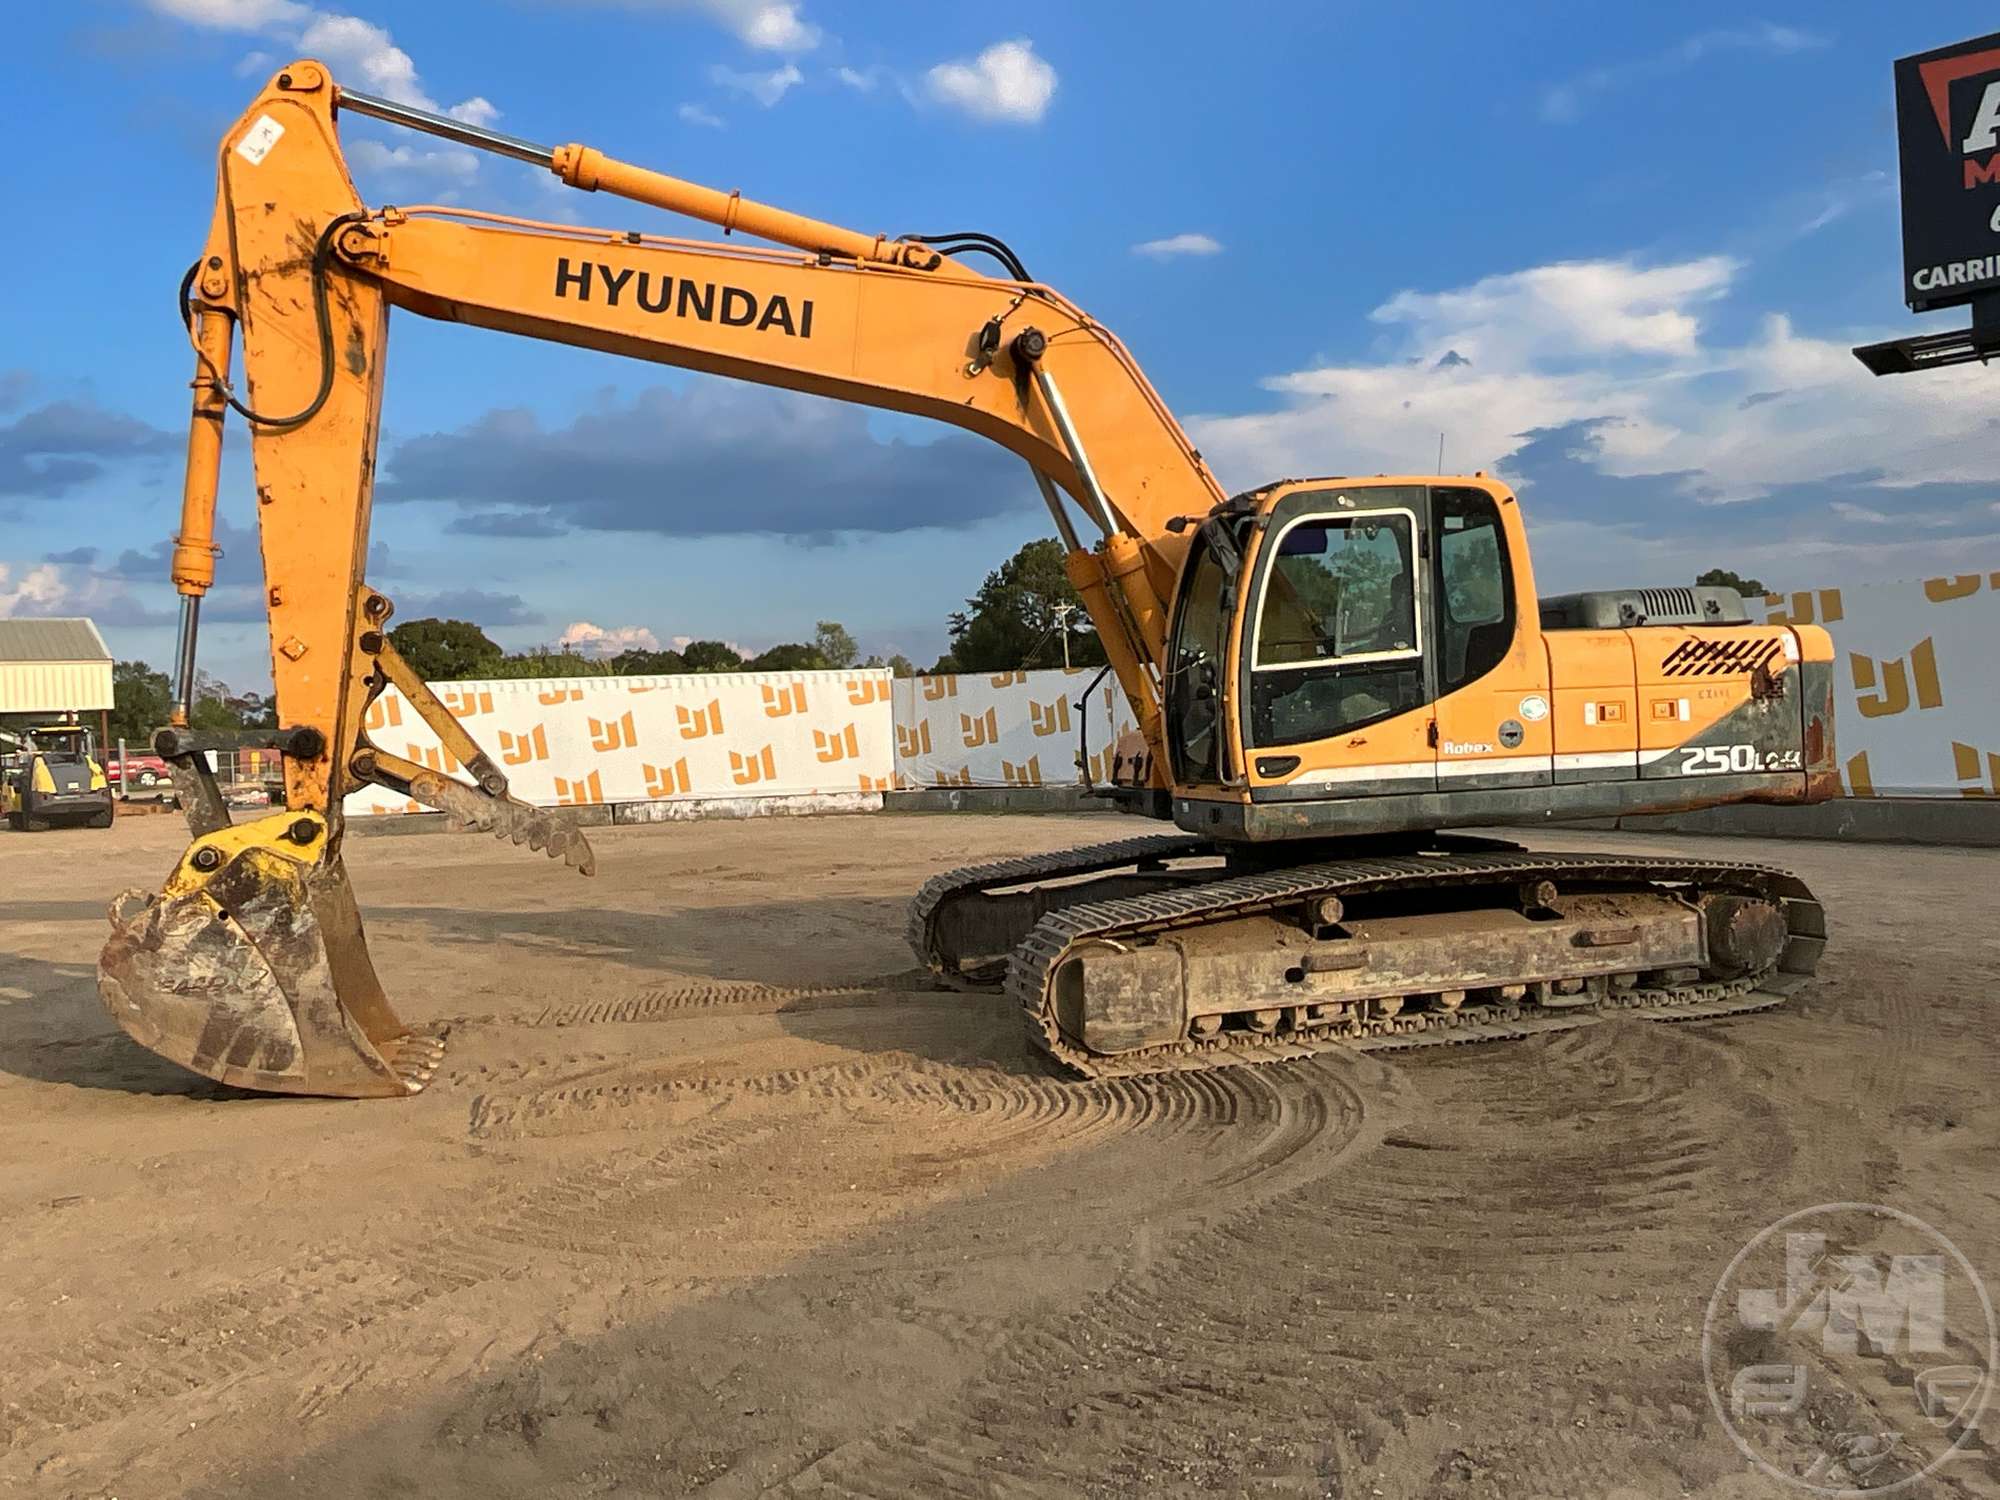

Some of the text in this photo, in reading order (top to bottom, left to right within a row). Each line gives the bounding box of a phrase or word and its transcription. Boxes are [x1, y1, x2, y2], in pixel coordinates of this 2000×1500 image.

[1912, 255, 2000, 291] CARRI
[555, 257, 814, 339] HYUNDAI
[1443, 741, 1494, 755] Robex
